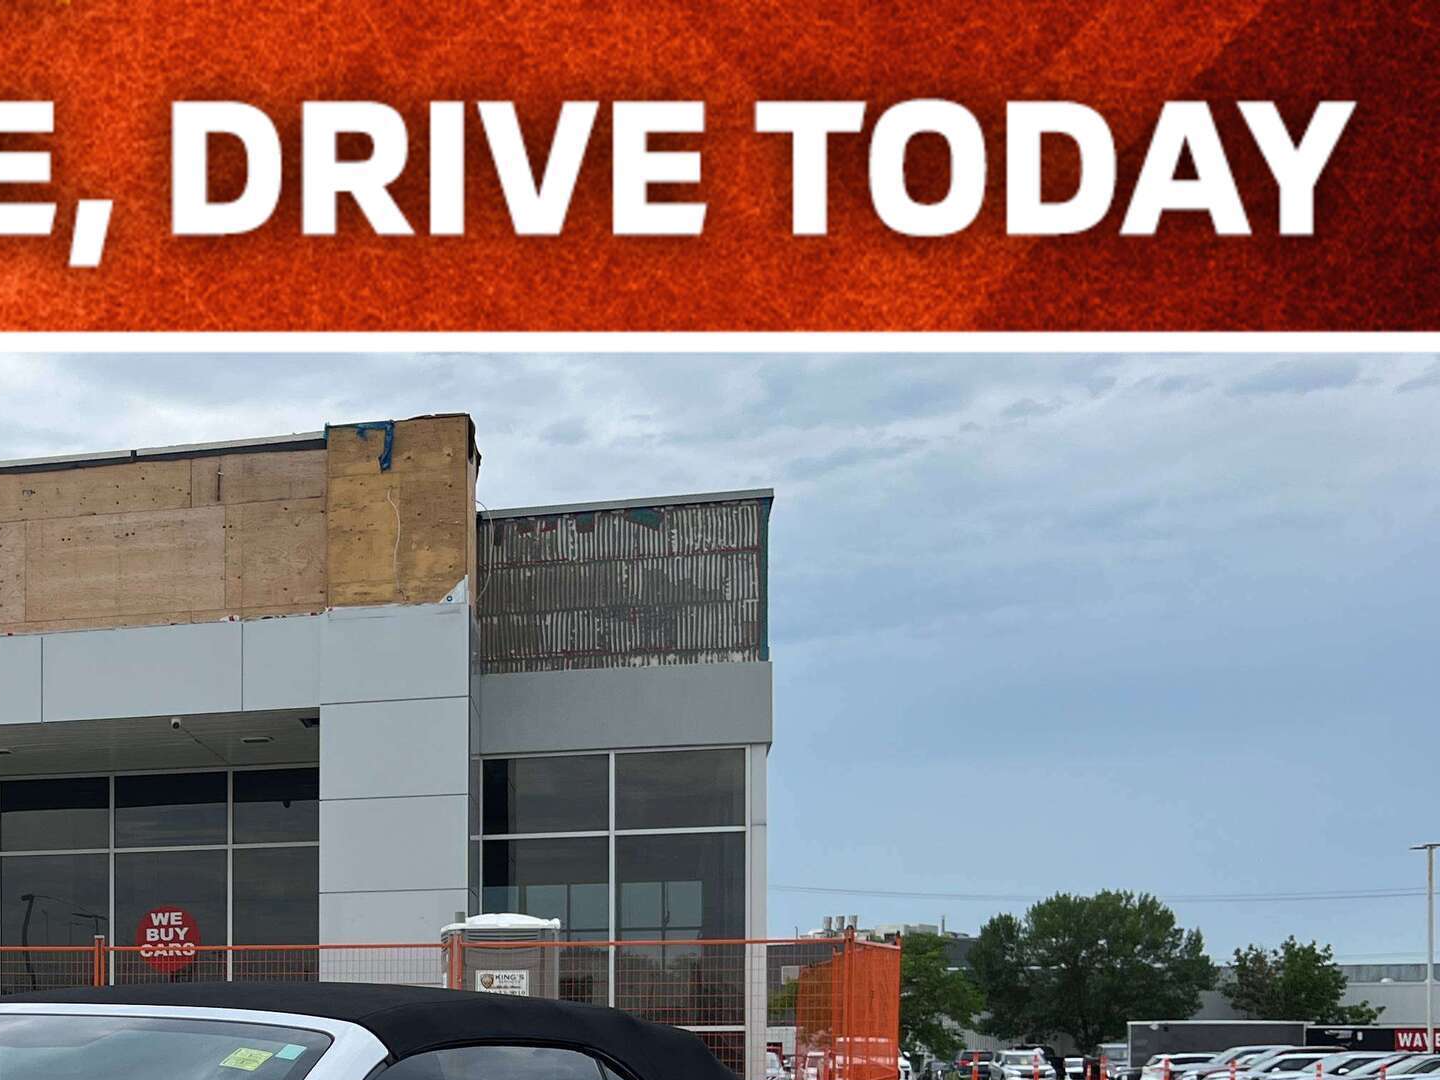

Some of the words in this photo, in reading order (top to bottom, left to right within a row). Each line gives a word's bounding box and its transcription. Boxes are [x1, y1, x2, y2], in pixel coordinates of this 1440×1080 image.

[150, 911, 183, 926] WE
[146, 927, 190, 942] BUY
[140, 942, 196, 958] CARS
